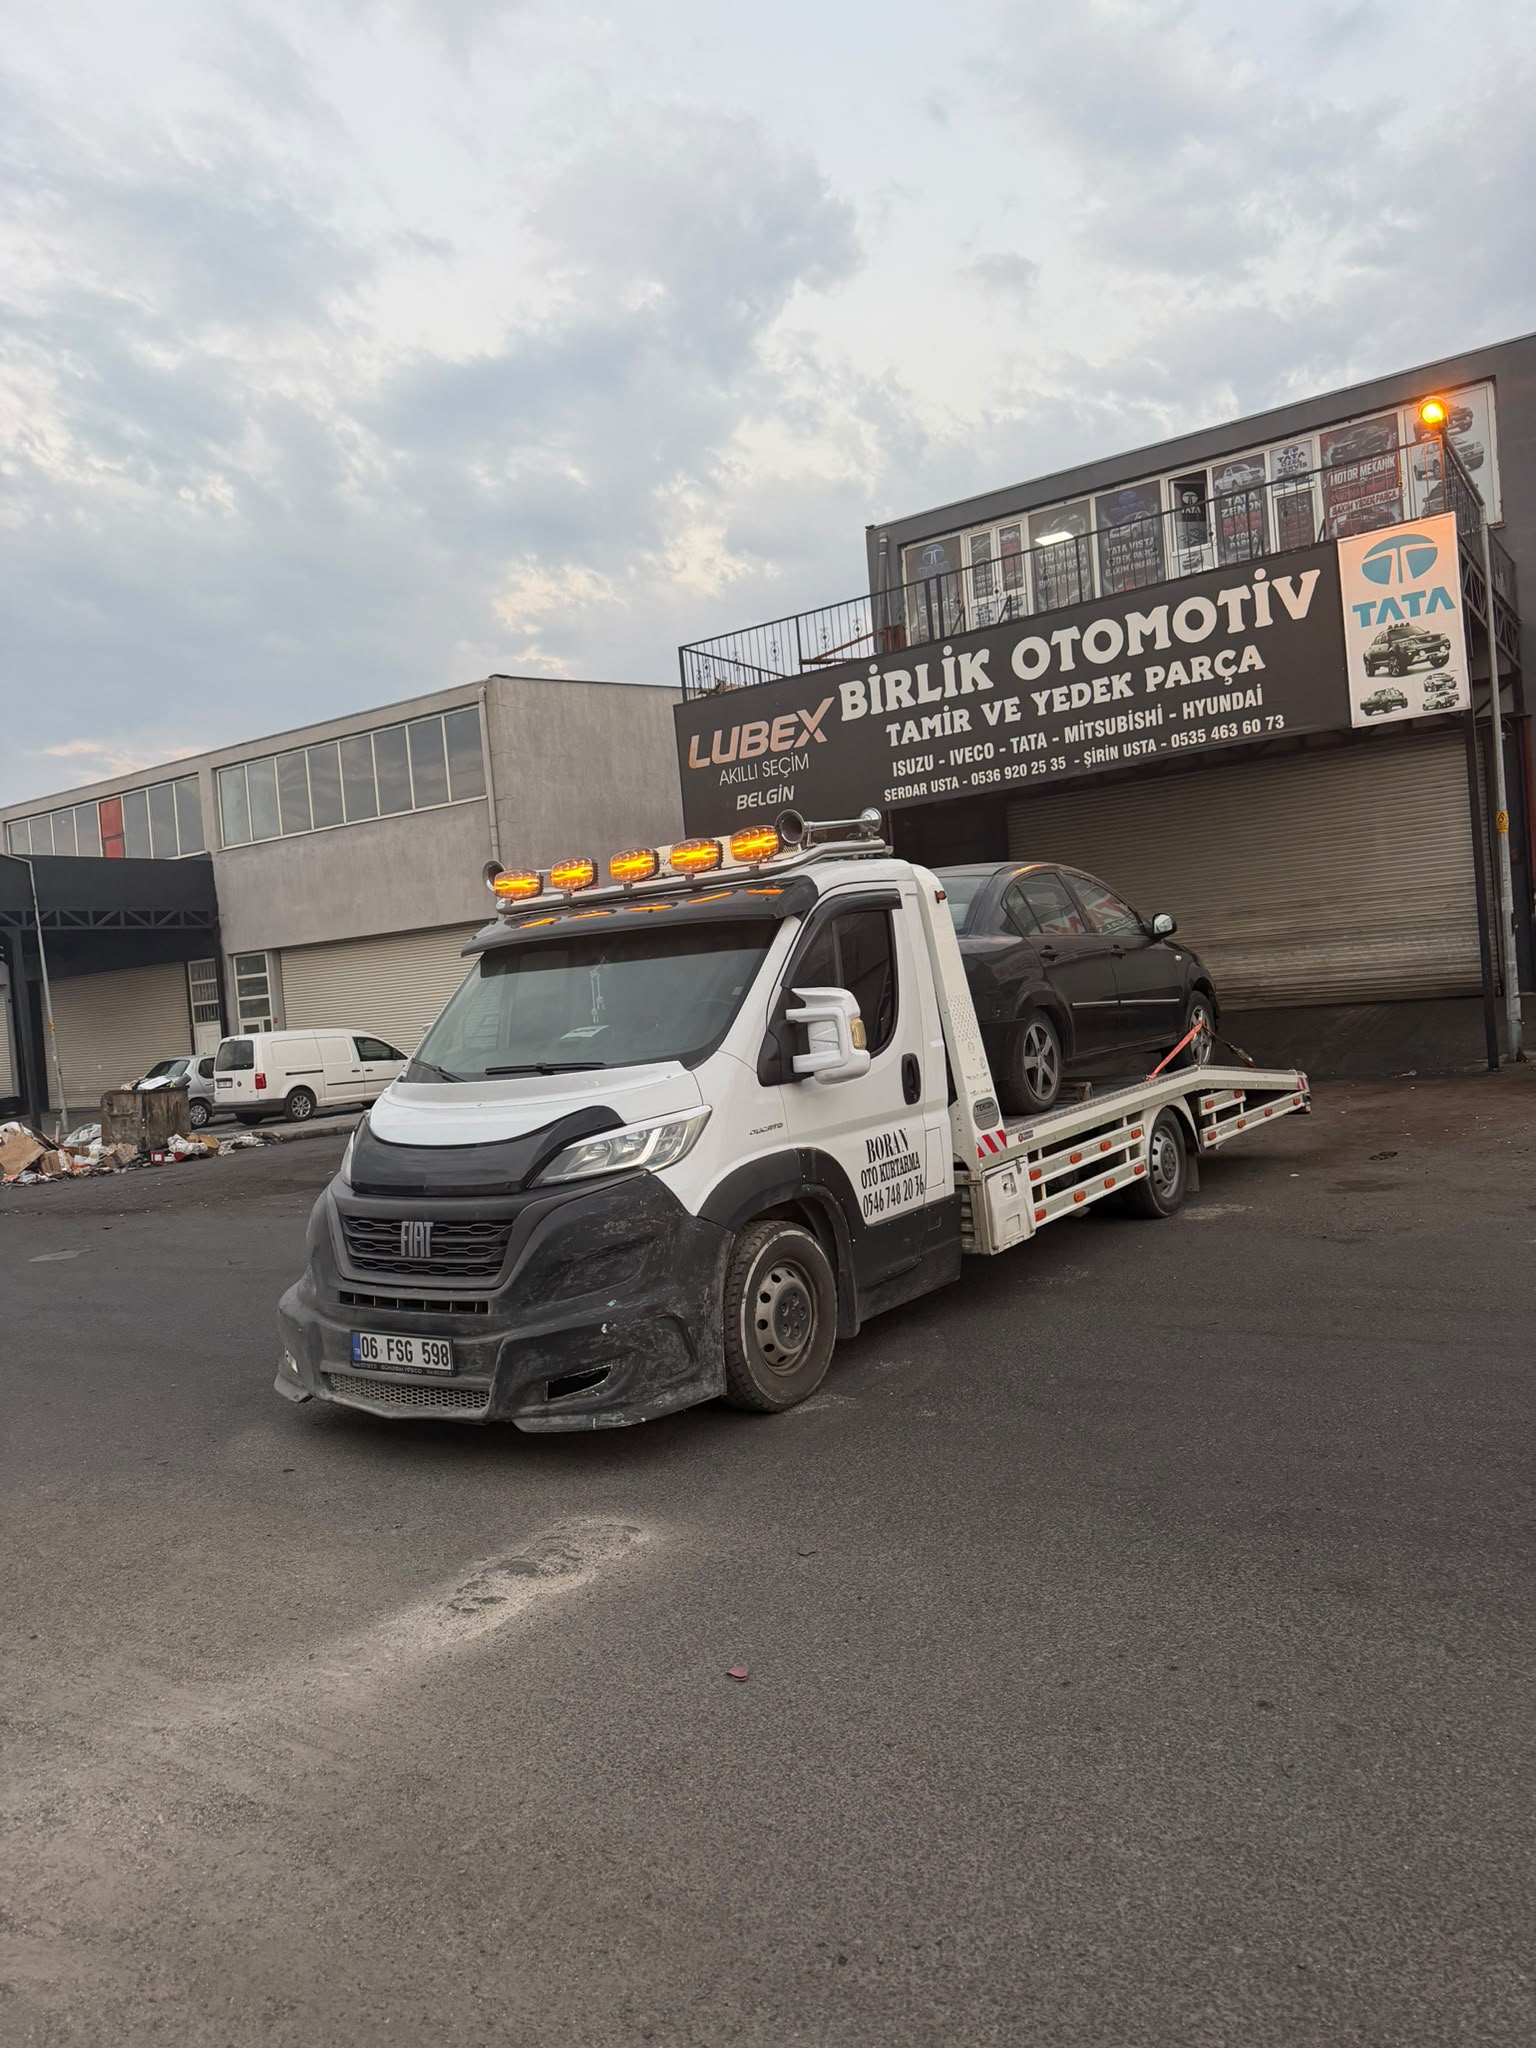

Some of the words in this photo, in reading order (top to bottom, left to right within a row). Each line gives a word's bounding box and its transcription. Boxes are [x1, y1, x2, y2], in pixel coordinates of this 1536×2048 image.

[1330, 467, 1358, 487] MOTOR
[1225, 491, 1257, 507] TATA
[1352, 585, 1456, 628] TATA
[839, 646, 995, 722] BİRLİK
[1011, 567, 1321, 681] OTOMOTİV
[885, 704, 973, 747] TAMİR
[980, 696, 1022, 727] VE
[1030, 676, 1134, 716] YEDEK
[1144, 644, 1267, 693] PARÇA
[688, 697, 835, 769] LUBEX
[892, 755, 934, 778] ISUZU
[949, 742, 995, 767] IVECO
[1009, 731, 1048, 754] TATA
[1063, 703, 1163, 744] MİTSUBİSHİ
[1182, 683, 1263, 720] HYUNDAİ
[719, 763, 759, 787] AKILLI
[762, 752, 810, 779] SEÇİM
[883, 780, 928, 802] SERDAR
[930, 775, 960, 793] USTA
[970, 768, 1001, 786] 0536
[1004, 763, 1028, 780] 920
[1030, 760, 1047, 775] 25
[1050, 756, 1067, 771] 35
[1083, 743, 1119, 769] ŞİRİN
[1123, 738, 1157, 758] USTA
[1170, 728, 1207, 749] 0535
[1210, 722, 1239, 740] 463
[1242, 718, 1261, 735] 60
[1265, 714, 1285, 731] 73
[736, 784, 795, 811] BELGİN
[865, 1127, 909, 1164] BORAN
[861, 1166, 879, 1189] OTO
[879, 1151, 921, 1182] KURTARMA
[863, 1189, 885, 1218] 0546
[885, 1182, 902, 1209] 748
[903, 1177, 914, 1202] 20
[400, 1221, 434, 1258] FIAT
[361, 1336, 378, 1359] 06
[386, 1338, 413, 1363] FSG
[421, 1341, 450, 1367] 598
